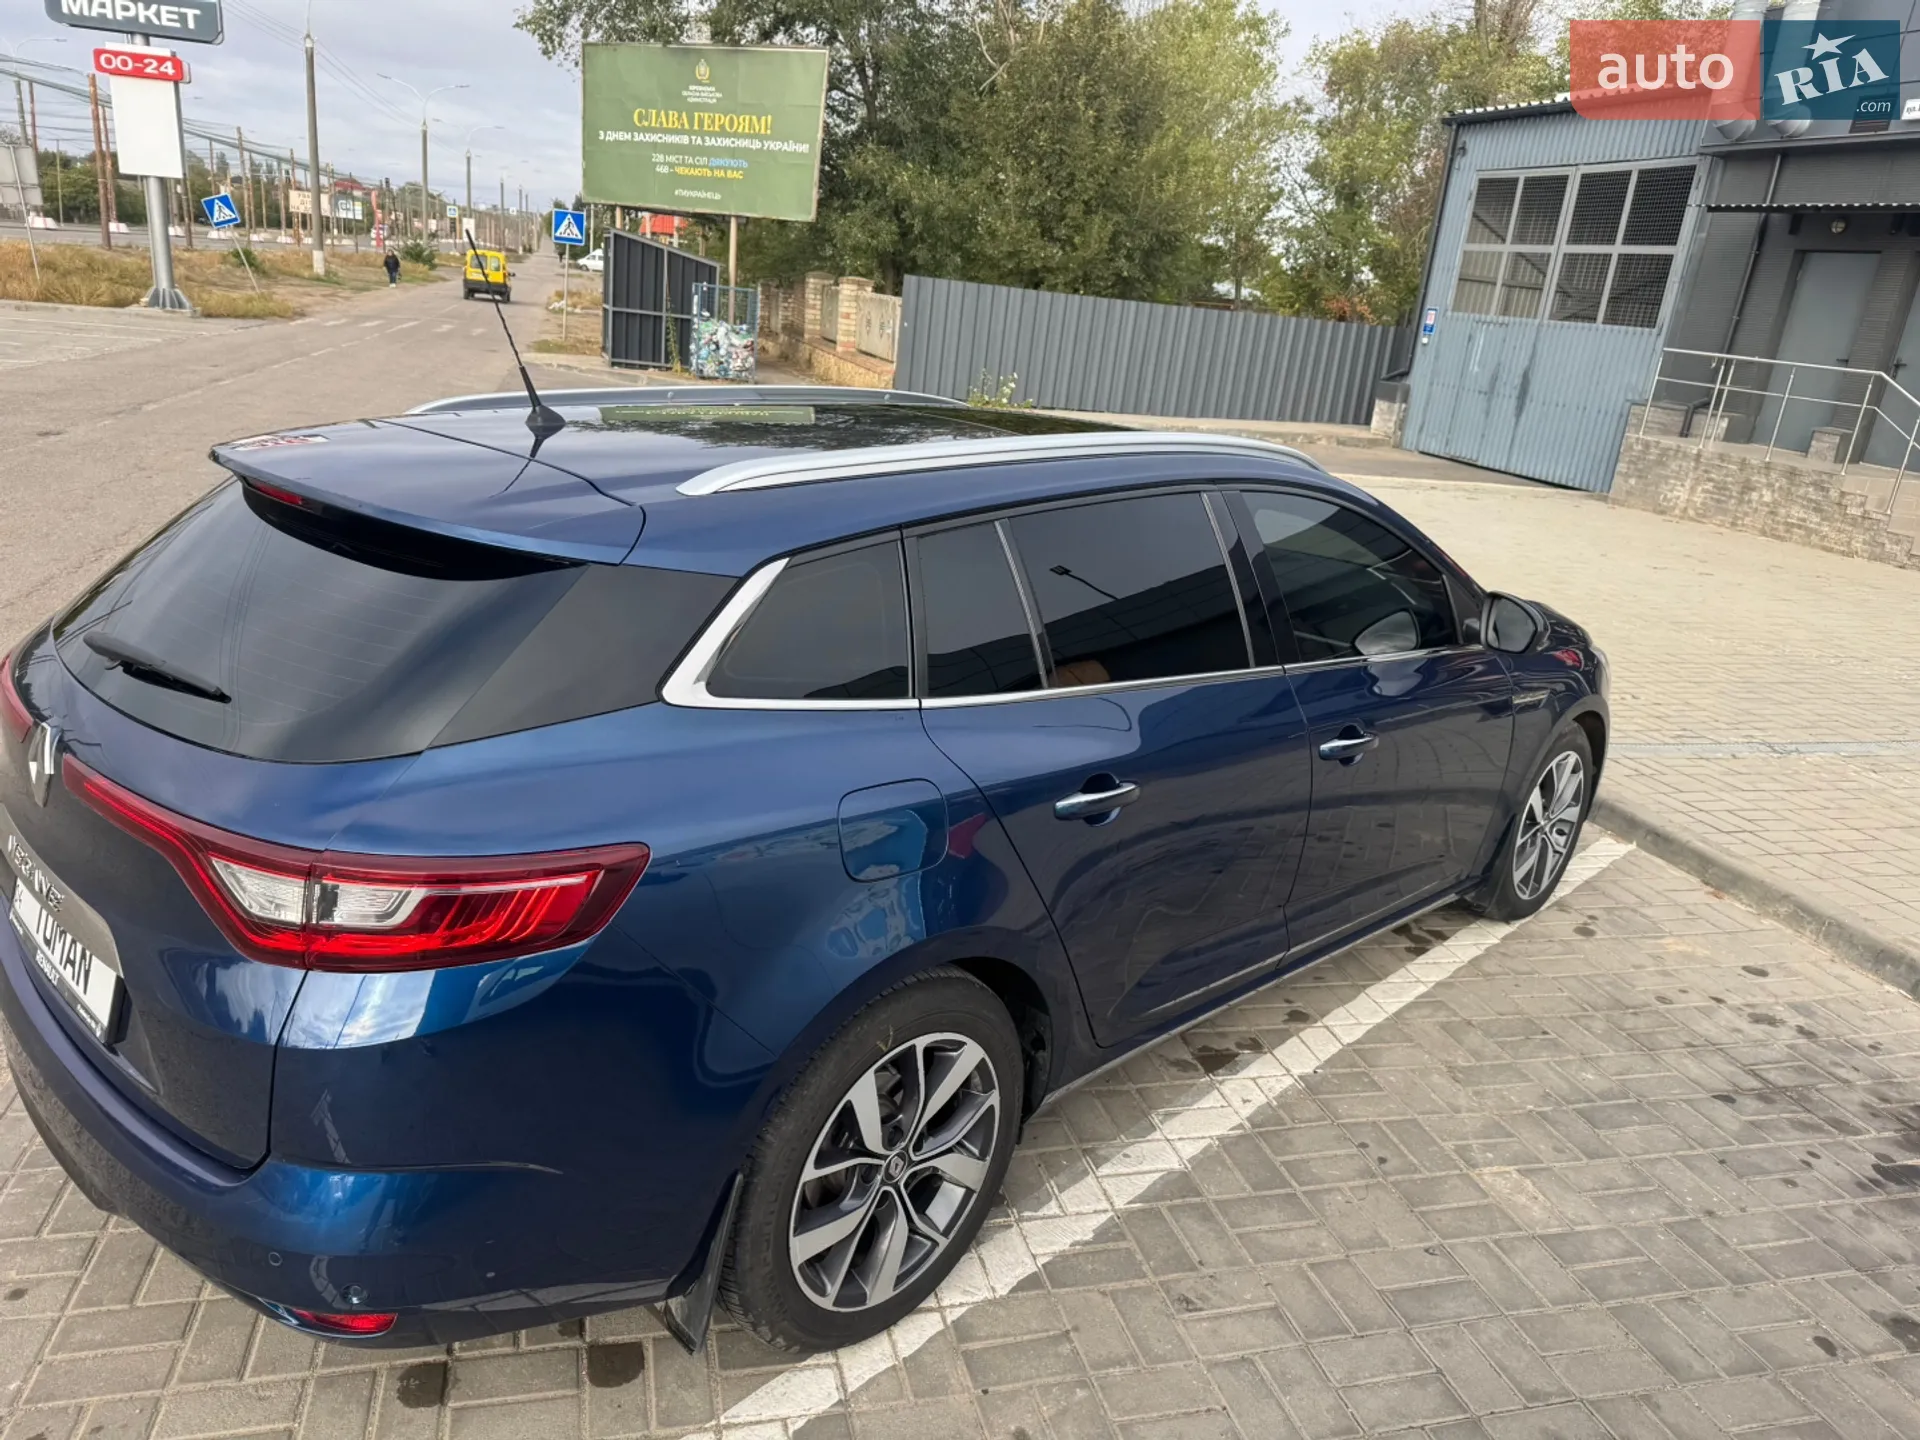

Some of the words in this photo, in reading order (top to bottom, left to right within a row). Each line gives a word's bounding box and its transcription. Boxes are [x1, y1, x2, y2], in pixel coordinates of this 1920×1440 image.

[60, 0, 202, 30] МАРКЕТ
[99, 53, 176, 76] 00-24
[633, 107, 690, 130] СЛАВА
[693, 111, 773, 135] ГЕРОЯМ!
[598, 130, 605, 140] З
[605, 130, 632, 142] ДНЕМ
[633, 132, 690, 145] ЗАХИСНИКІВ
[691, 135, 703, 146] ТА
[704, 136, 762, 151] ЗАХИСНИЦЬ
[674, 166, 713, 178] ЧЕКАЮТЬ
[713, 169, 726, 178] НА
